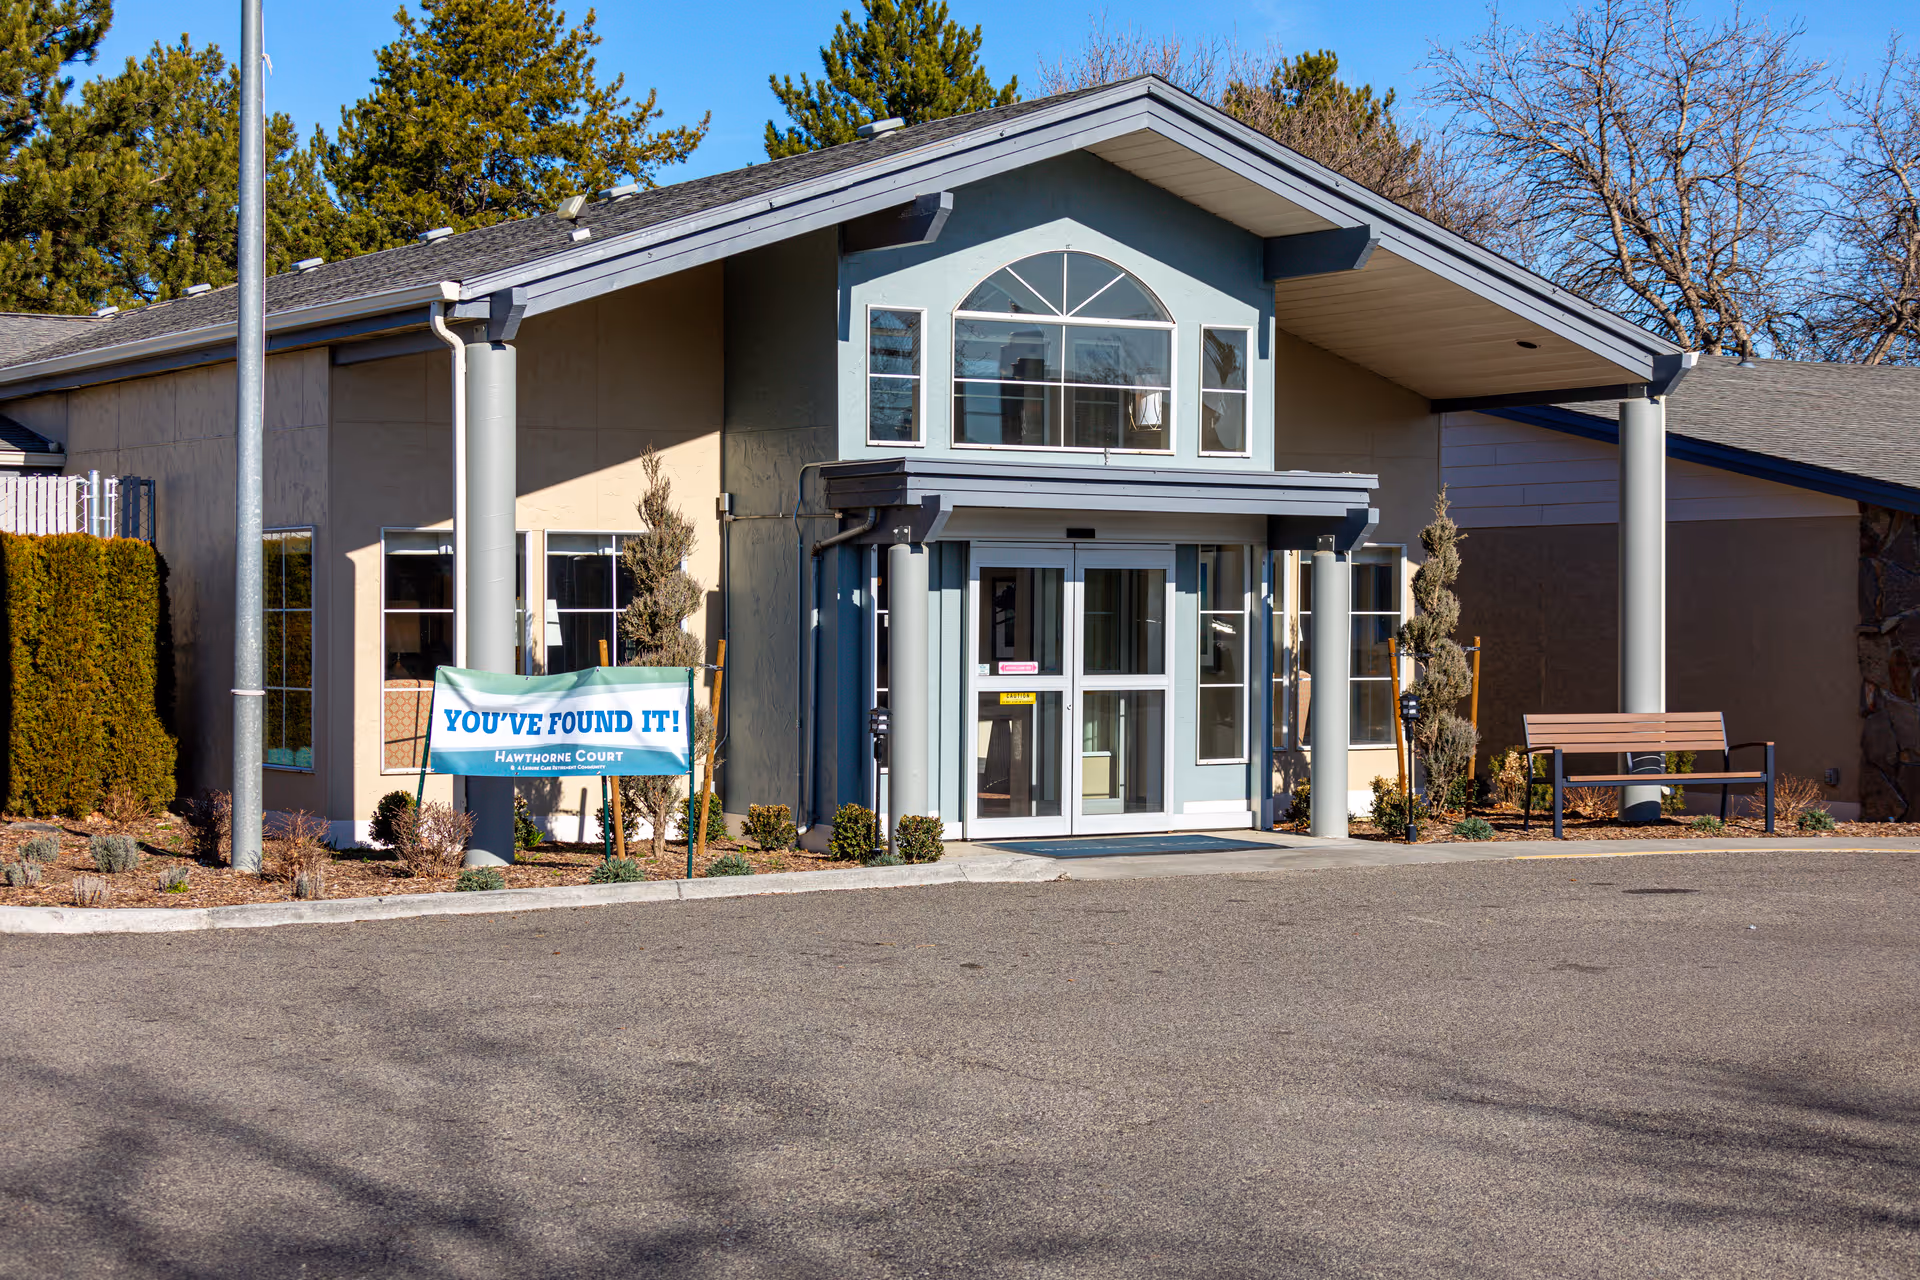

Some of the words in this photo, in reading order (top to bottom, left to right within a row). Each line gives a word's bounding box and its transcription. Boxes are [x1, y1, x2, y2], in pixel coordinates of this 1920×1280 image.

[444, 709, 543, 735] YOU'VE
[548, 710, 633, 734] FOUND
[641, 710, 679, 732] IT!
[494, 750, 571, 763] HAWTHORNE
[575, 749, 623, 762] COURT
